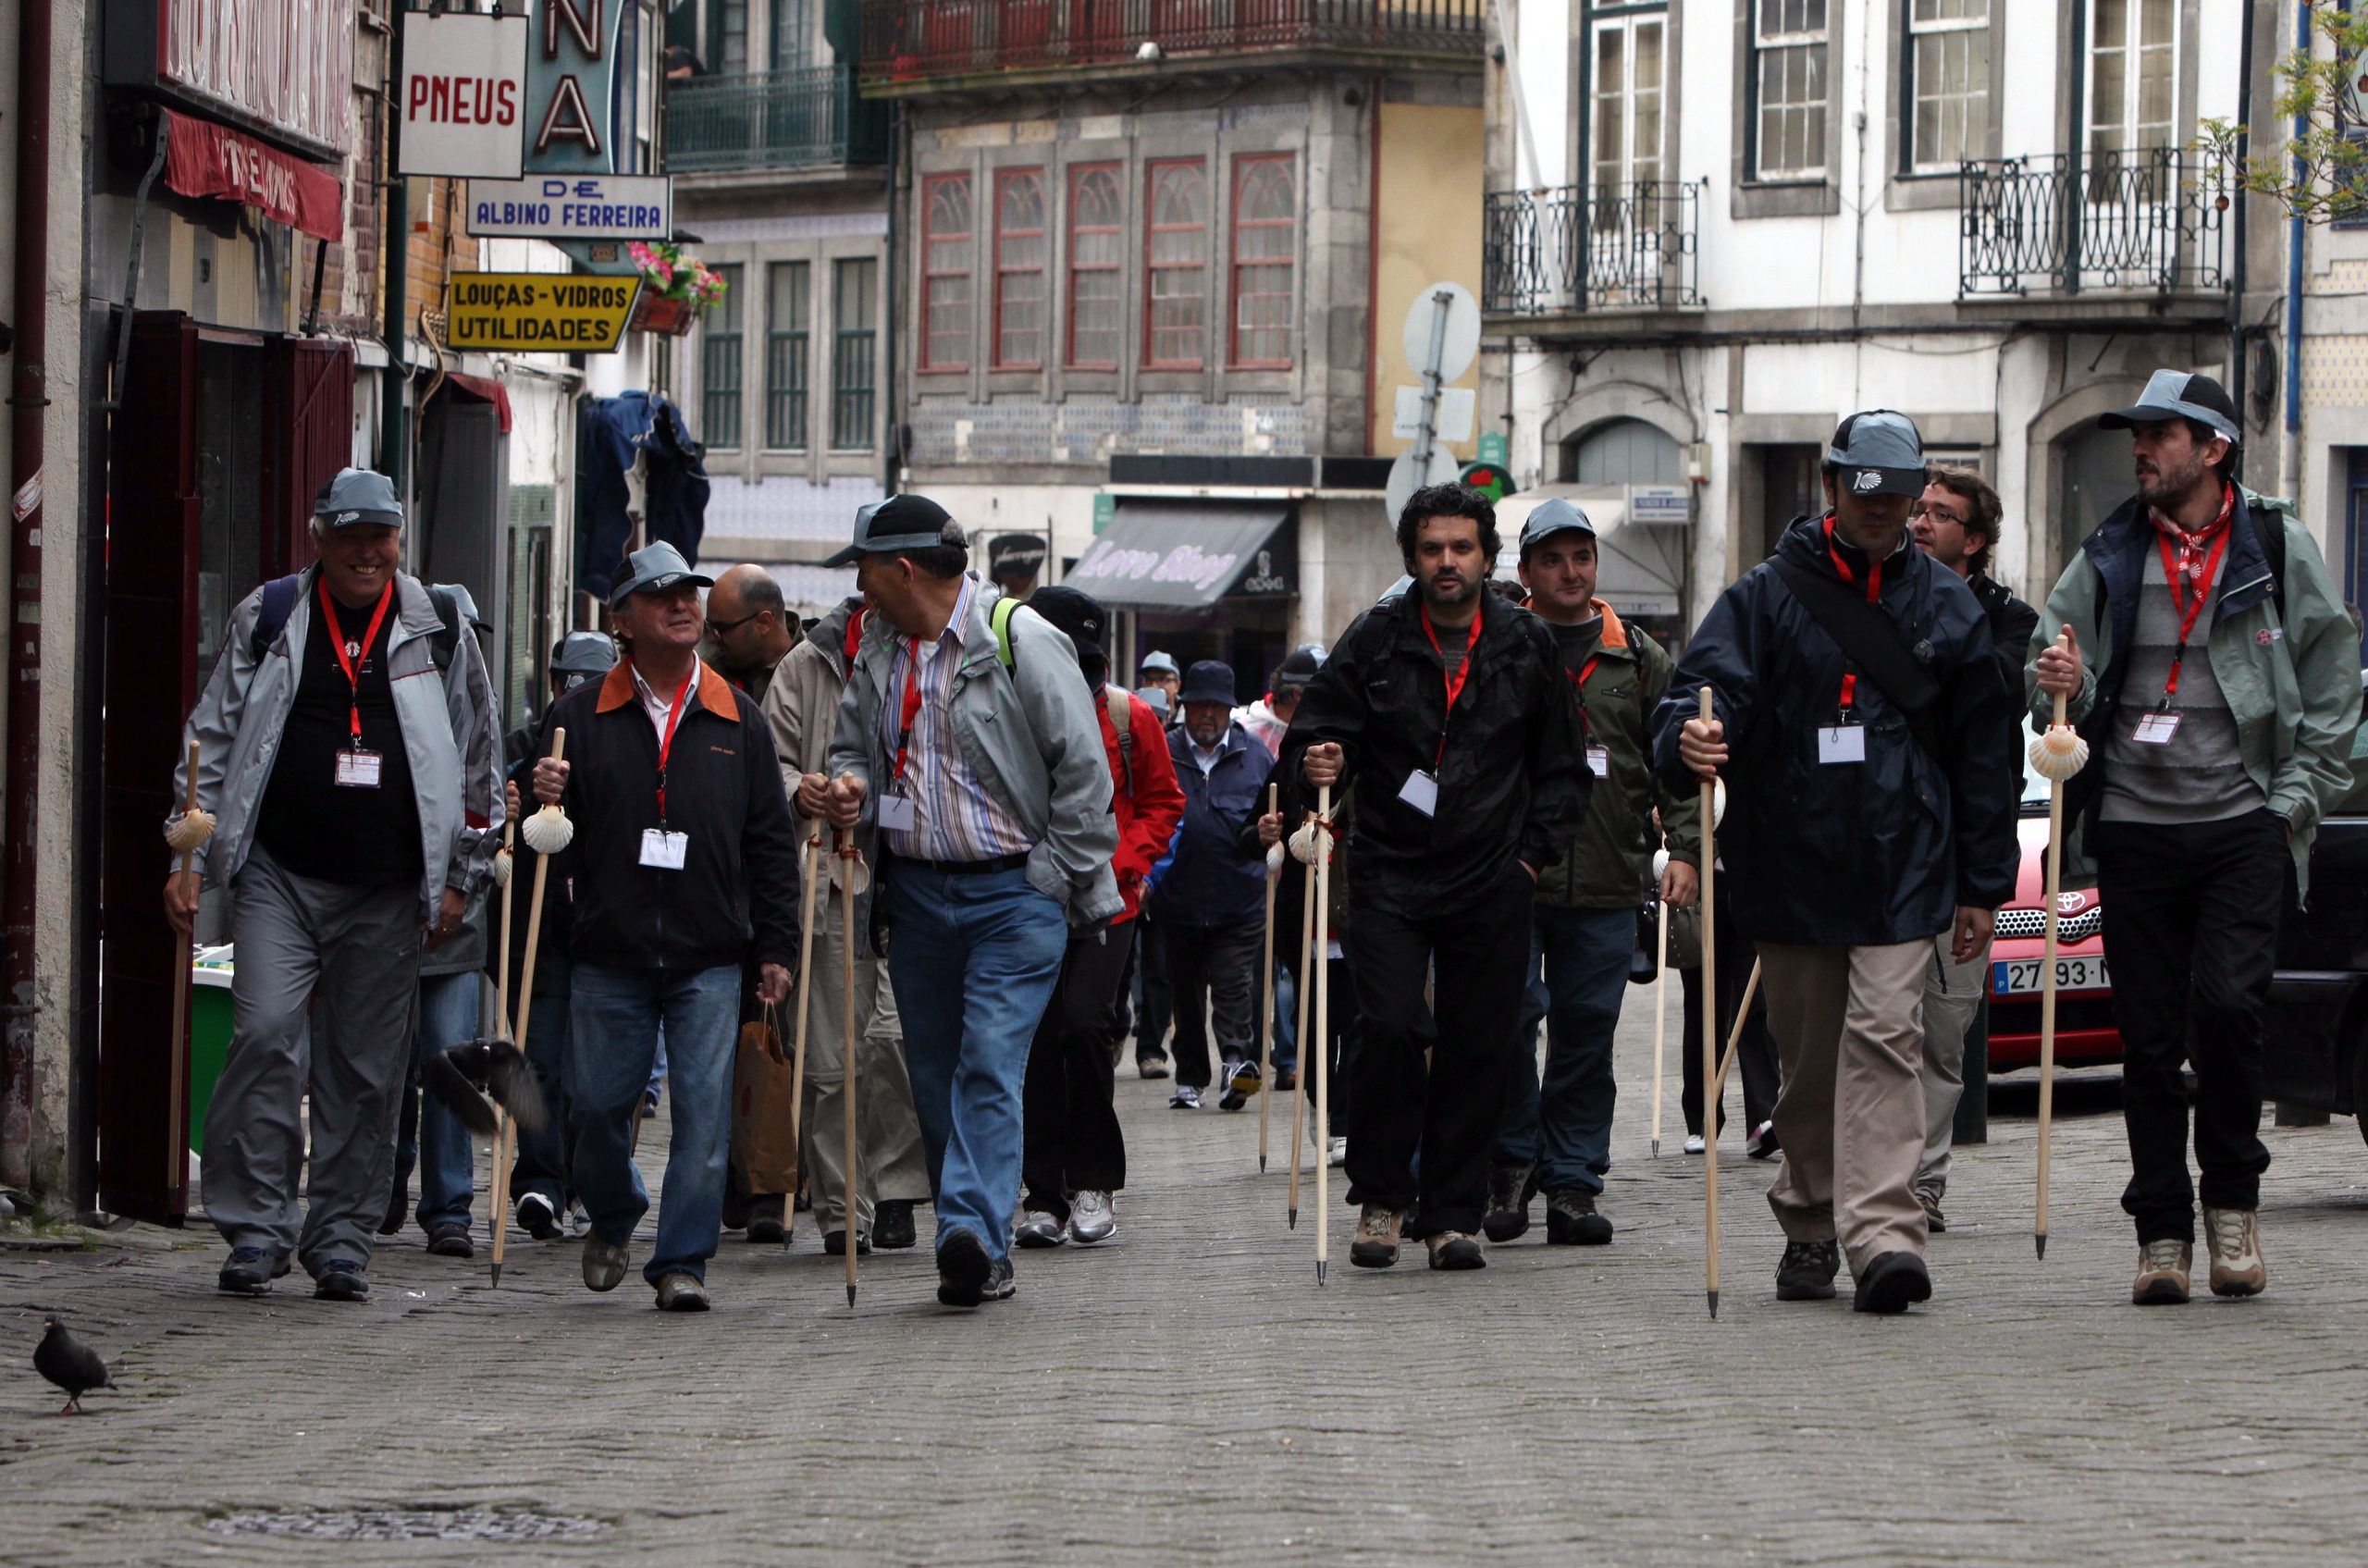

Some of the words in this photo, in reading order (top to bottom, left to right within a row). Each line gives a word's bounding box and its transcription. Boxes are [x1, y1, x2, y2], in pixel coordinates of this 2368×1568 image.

[409, 74, 516, 126] PNEUS
[543, 180, 604, 199] DE
[476, 202, 551, 225] ALBINO
[562, 204, 661, 228] FERREIRA
[457, 316, 610, 341] UTILIDADES
[1077, 540, 1159, 580] Love
